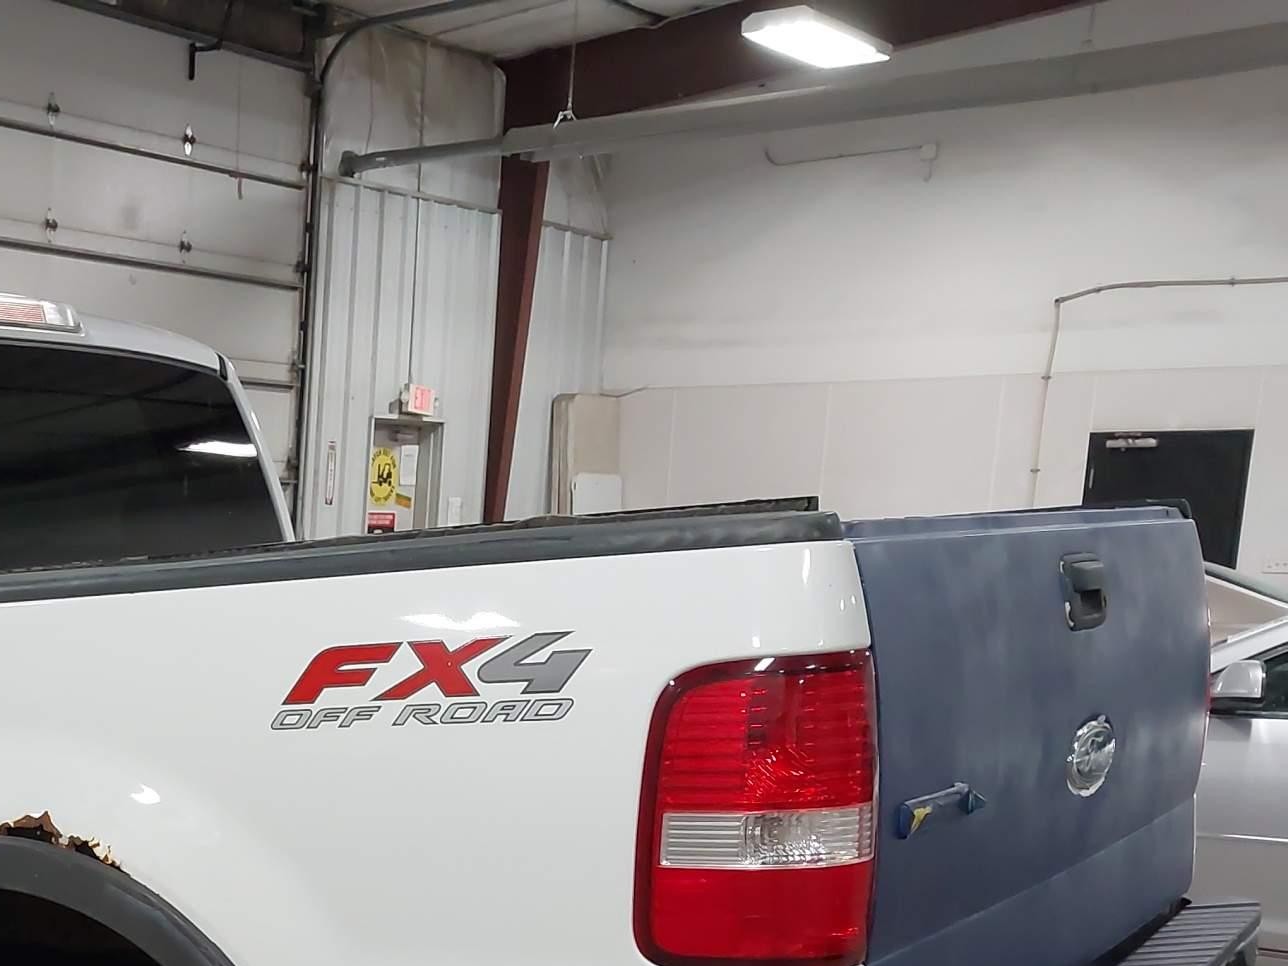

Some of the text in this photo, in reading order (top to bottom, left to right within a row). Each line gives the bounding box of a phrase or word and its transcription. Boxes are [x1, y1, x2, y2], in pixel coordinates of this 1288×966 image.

[281, 630, 594, 705] FX4
[270, 698, 575, 731] OFF ROAD
